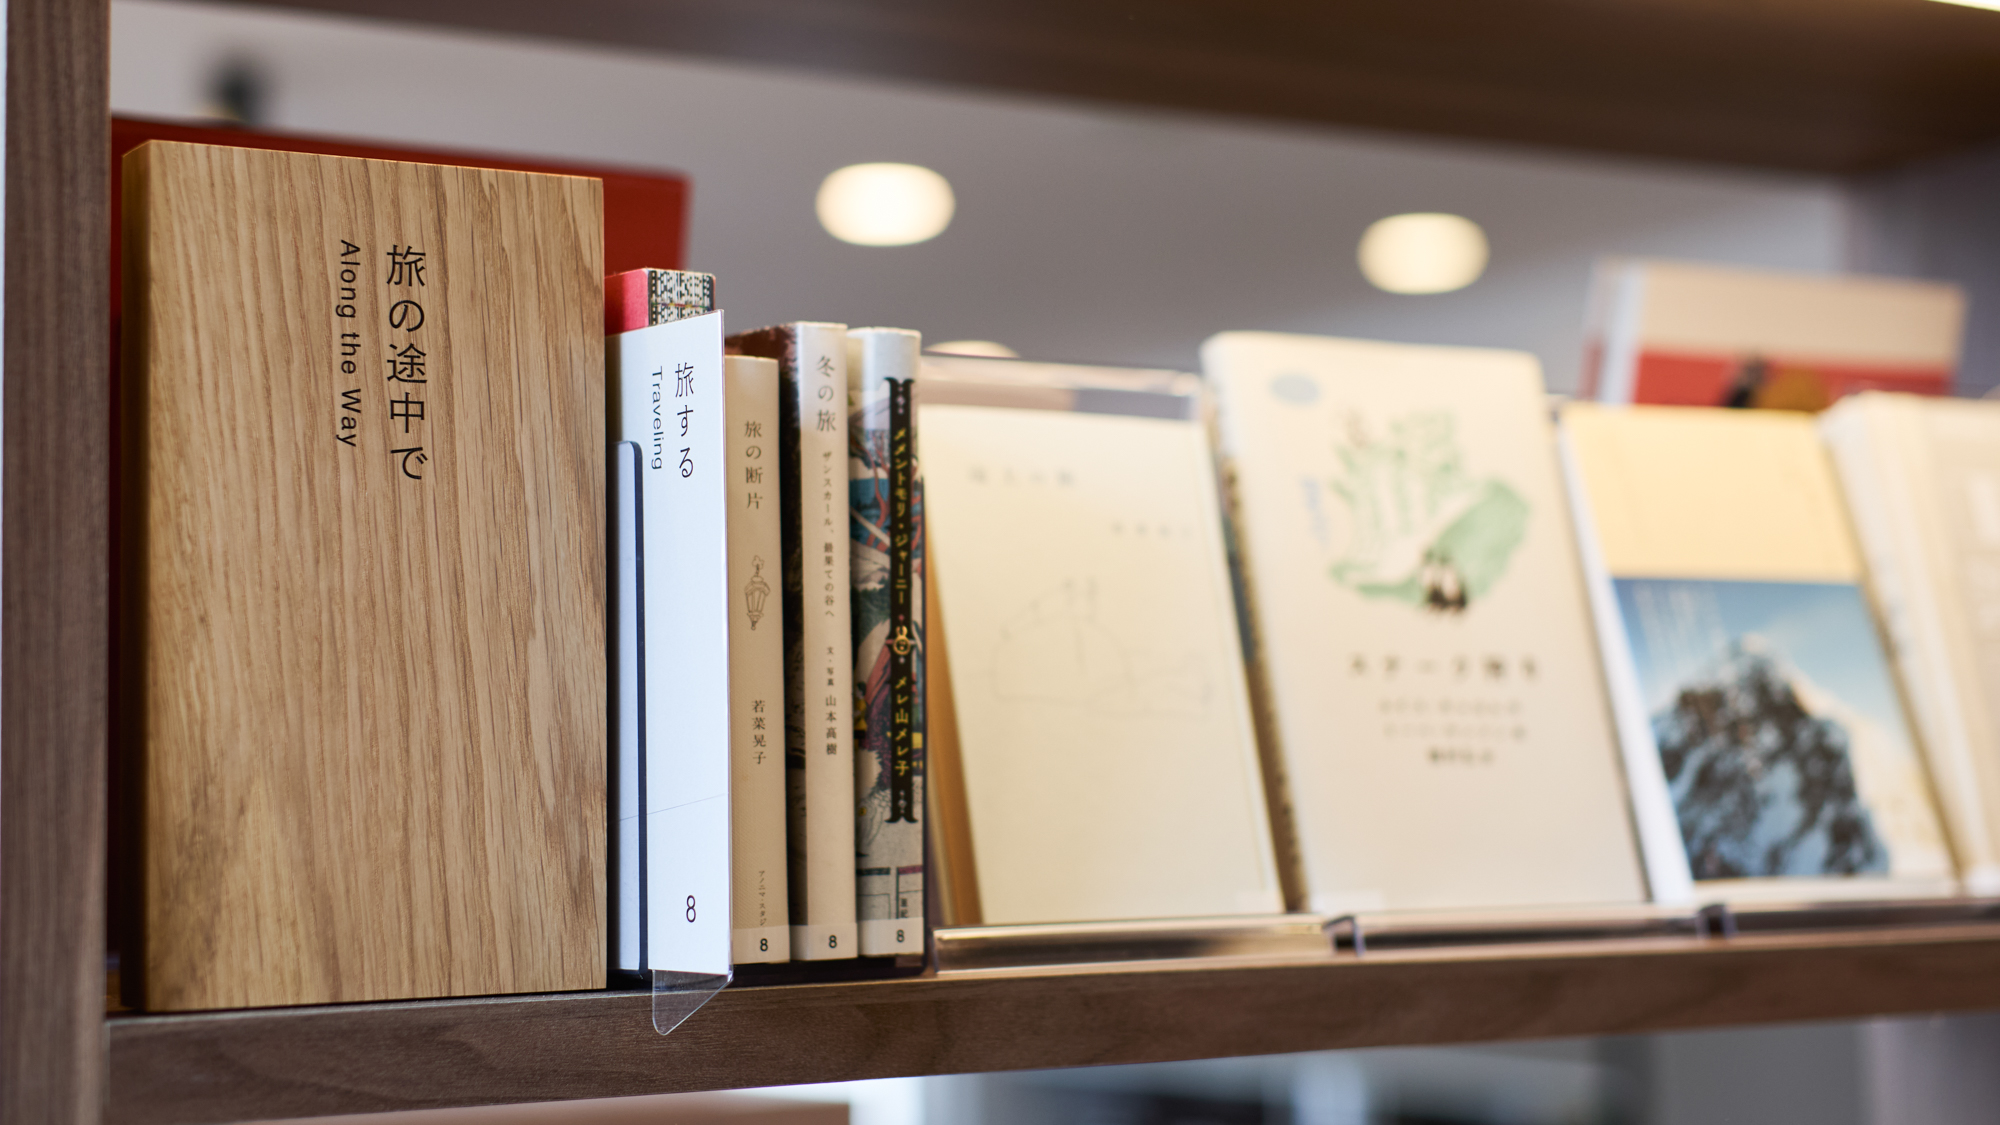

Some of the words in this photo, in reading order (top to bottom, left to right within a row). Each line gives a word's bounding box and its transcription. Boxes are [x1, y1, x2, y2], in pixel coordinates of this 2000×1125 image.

[335, 239, 361, 319] Along
[340, 331, 362, 375] the
[386, 244, 429, 480] 旅の途中で
[335, 388, 362, 448] Way
[651, 365, 665, 471] Traveling
[674, 361, 695, 479] 旅する
[816, 354, 837, 433] 冬の旅
[744, 420, 764, 511] 旅の断片
[894, 428, 909, 604] メメントモリ・ジャーニー
[751, 699, 767, 766] 若菜晃子
[895, 676, 910, 776] メレ山メレ子
[685, 894, 697, 923] 8
[759, 937, 769, 952] 8
[828, 934, 838, 949] 8
[895, 928, 905, 943] 8
